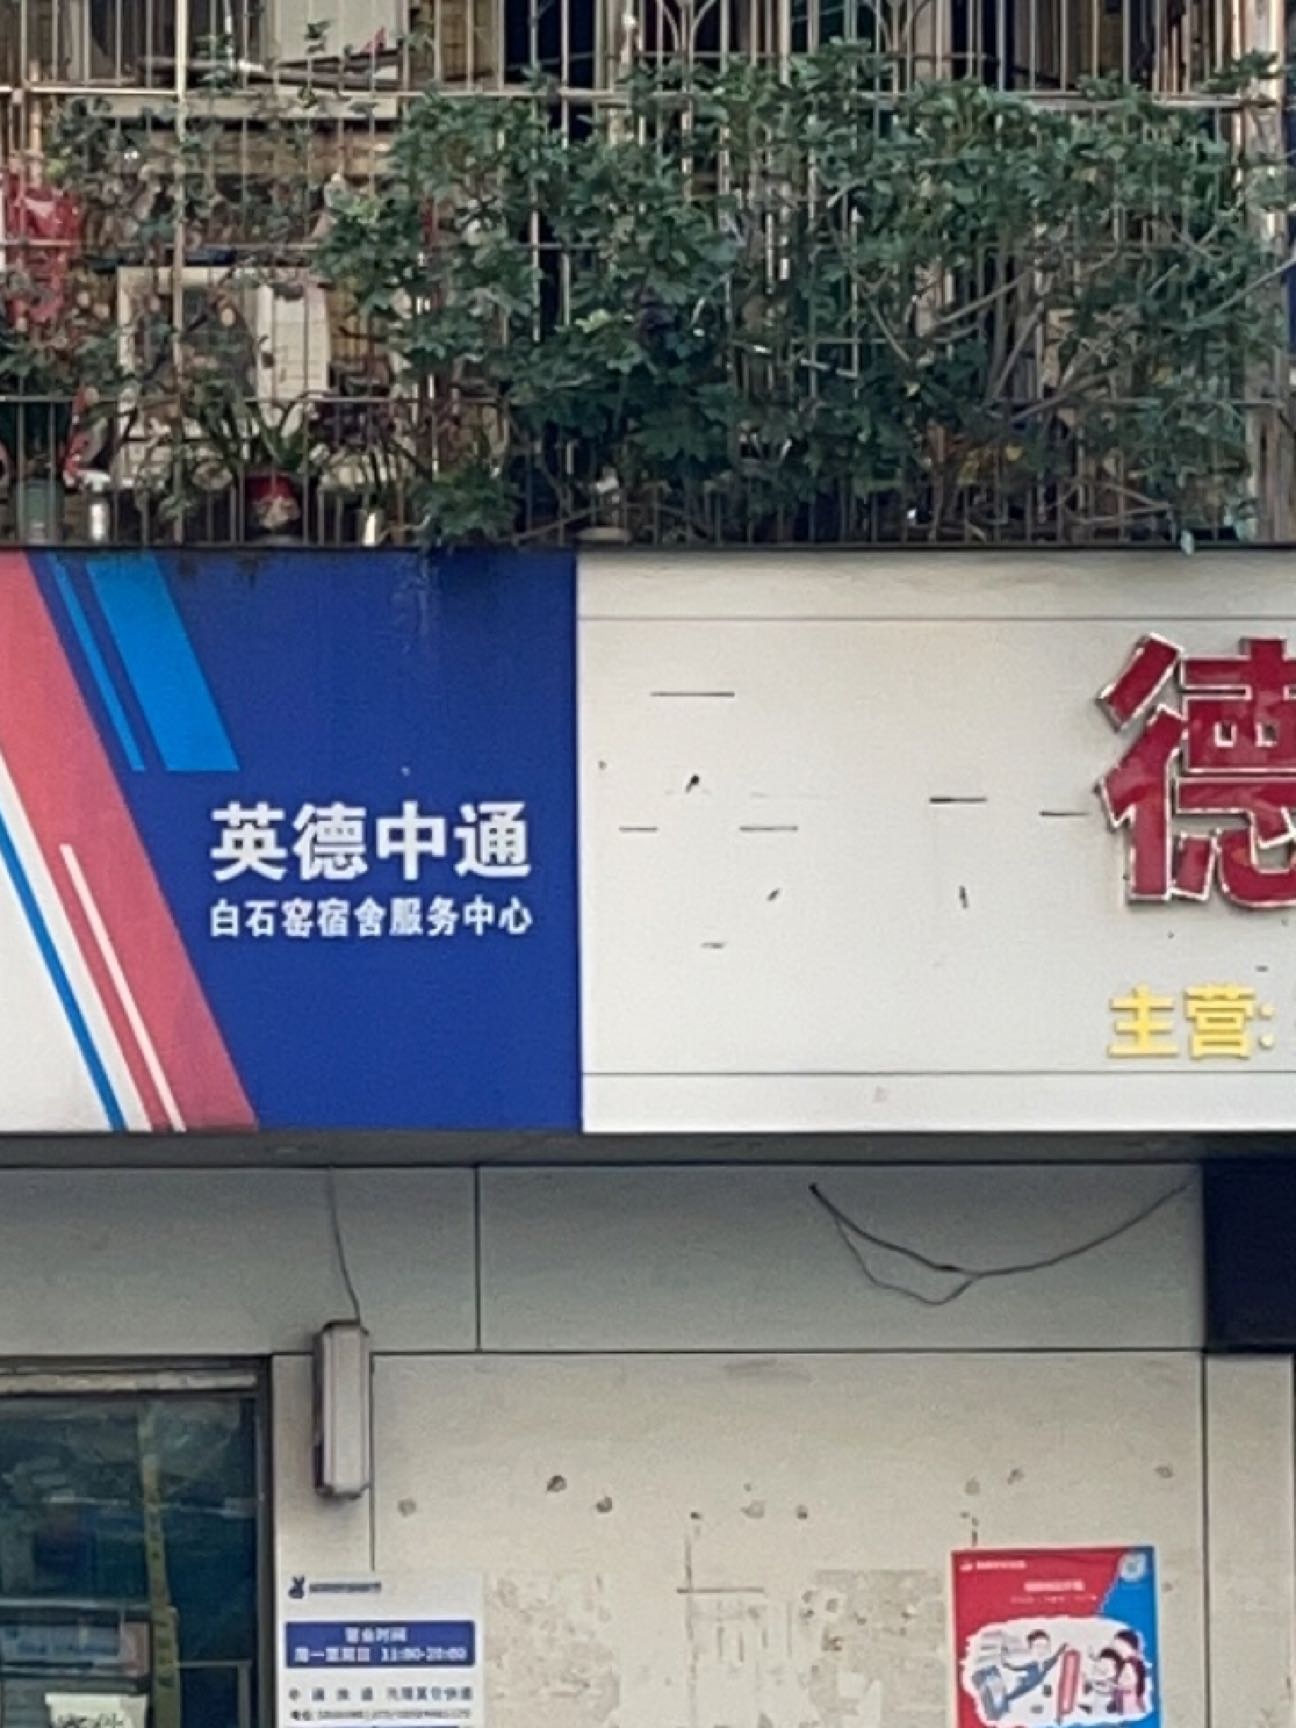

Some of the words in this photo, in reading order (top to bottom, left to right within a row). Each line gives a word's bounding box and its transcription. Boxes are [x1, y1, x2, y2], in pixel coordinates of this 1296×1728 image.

[1095, 632, 1296, 907] 德
[210, 801, 532, 882] 英德中通
[210, 897, 533, 938] 白石窑宿舍服务中心
